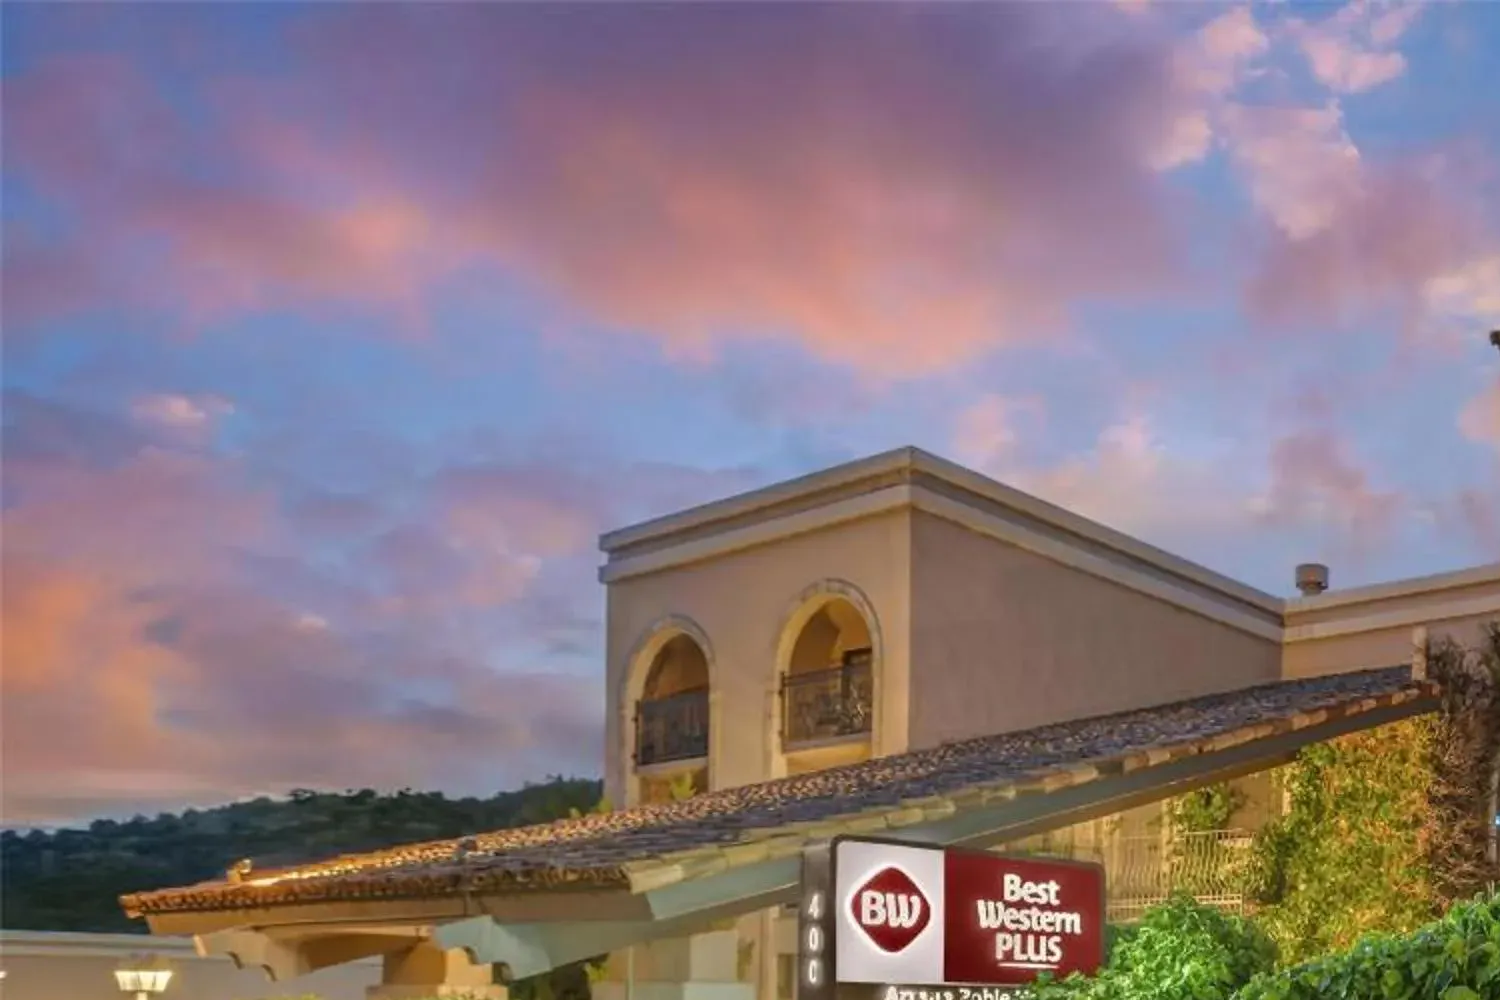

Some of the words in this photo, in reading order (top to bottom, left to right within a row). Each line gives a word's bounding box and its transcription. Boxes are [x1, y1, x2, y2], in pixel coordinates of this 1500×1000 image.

[1003, 873, 1060, 905] Best
[861, 889, 921, 928] BW
[978, 900, 1082, 934] Western
[995, 934, 1062, 963] PLUS
